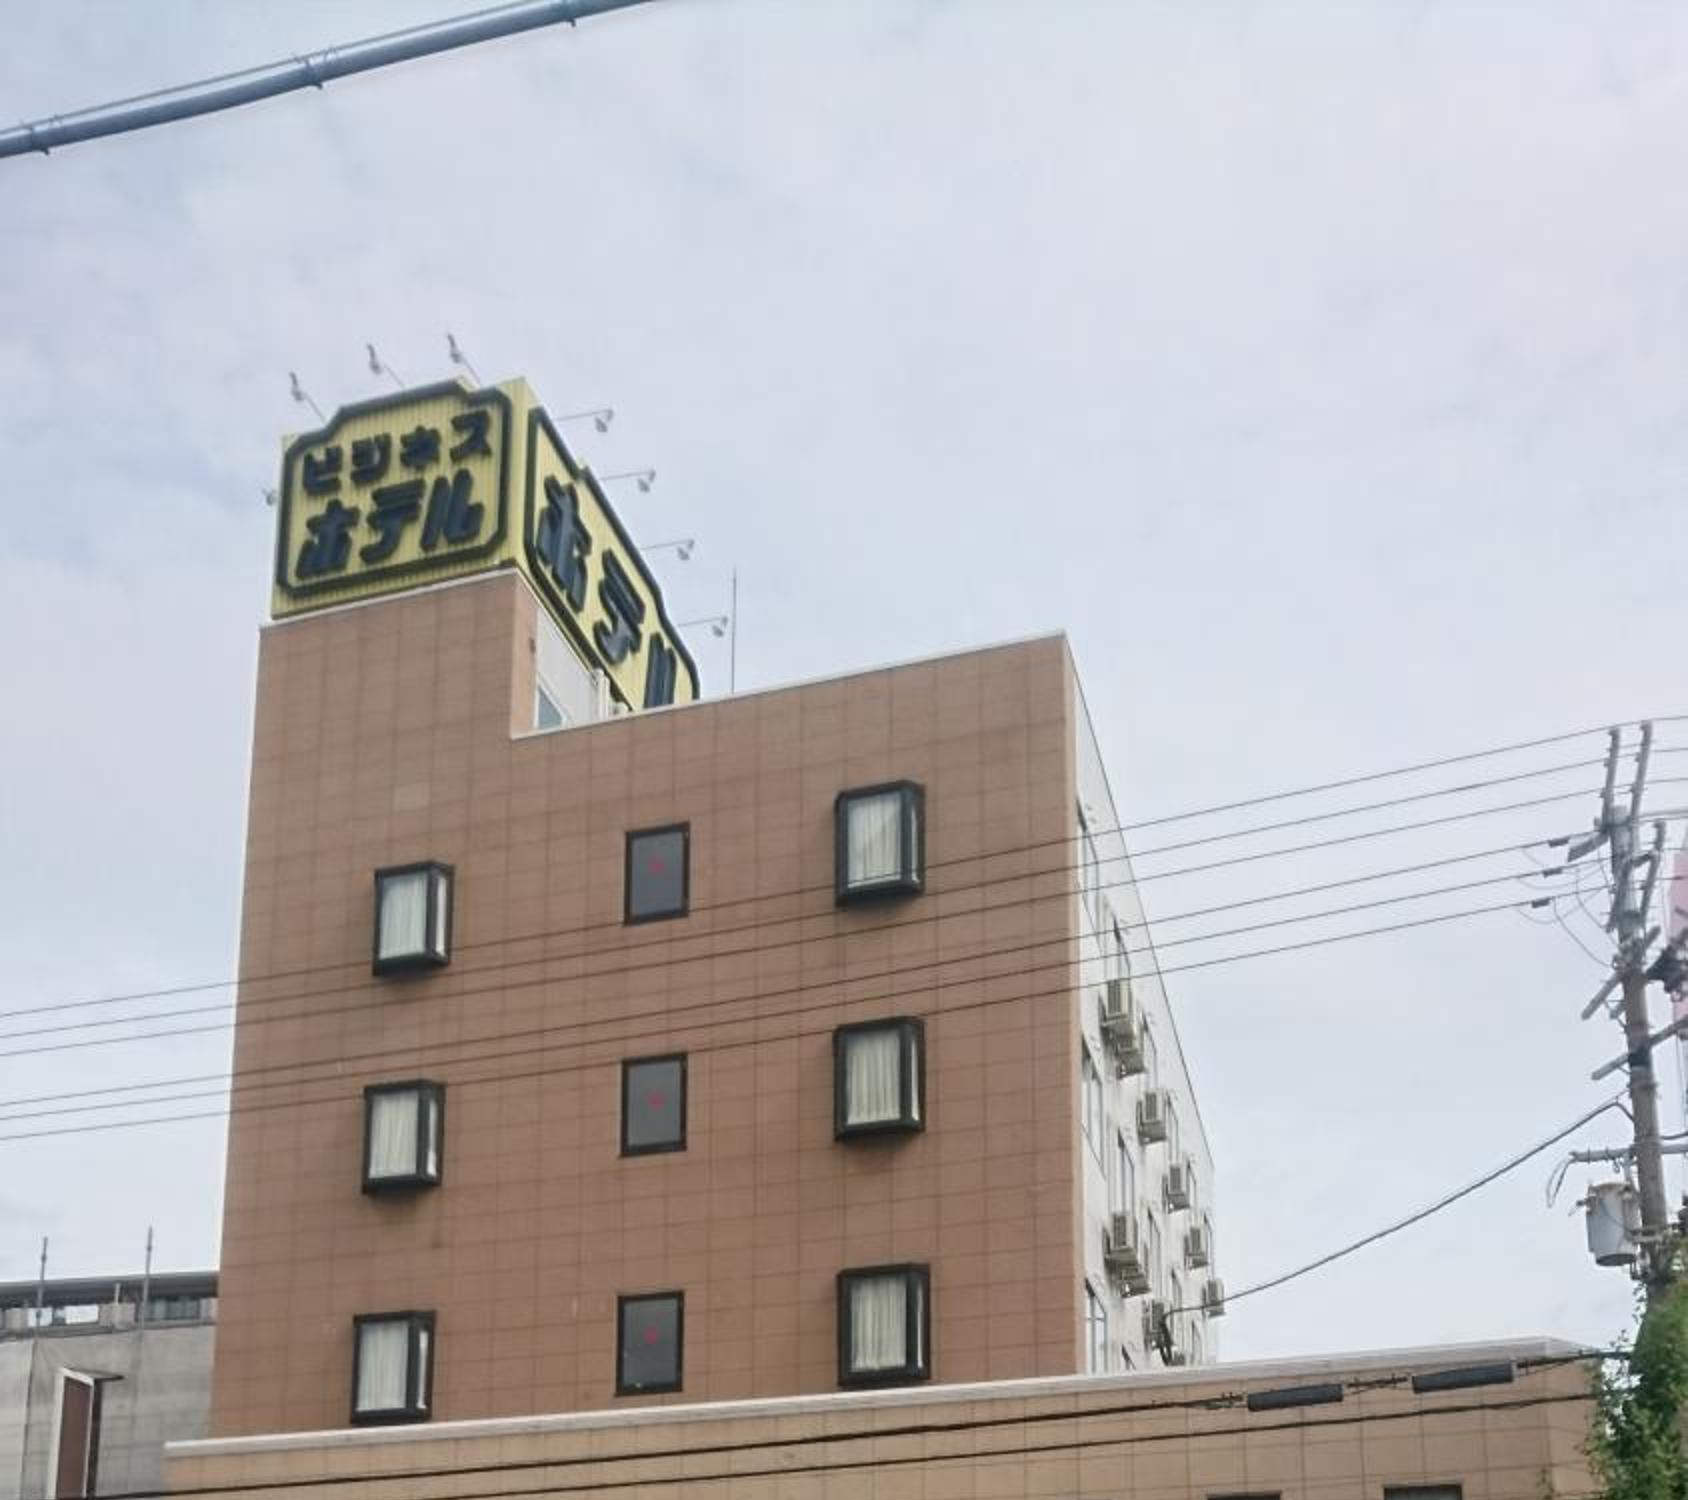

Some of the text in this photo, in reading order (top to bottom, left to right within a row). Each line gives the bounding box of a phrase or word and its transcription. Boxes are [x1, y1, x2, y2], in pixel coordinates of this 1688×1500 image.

[303, 409, 493, 496] ビジネス
[295, 468, 485, 580] ホテル
